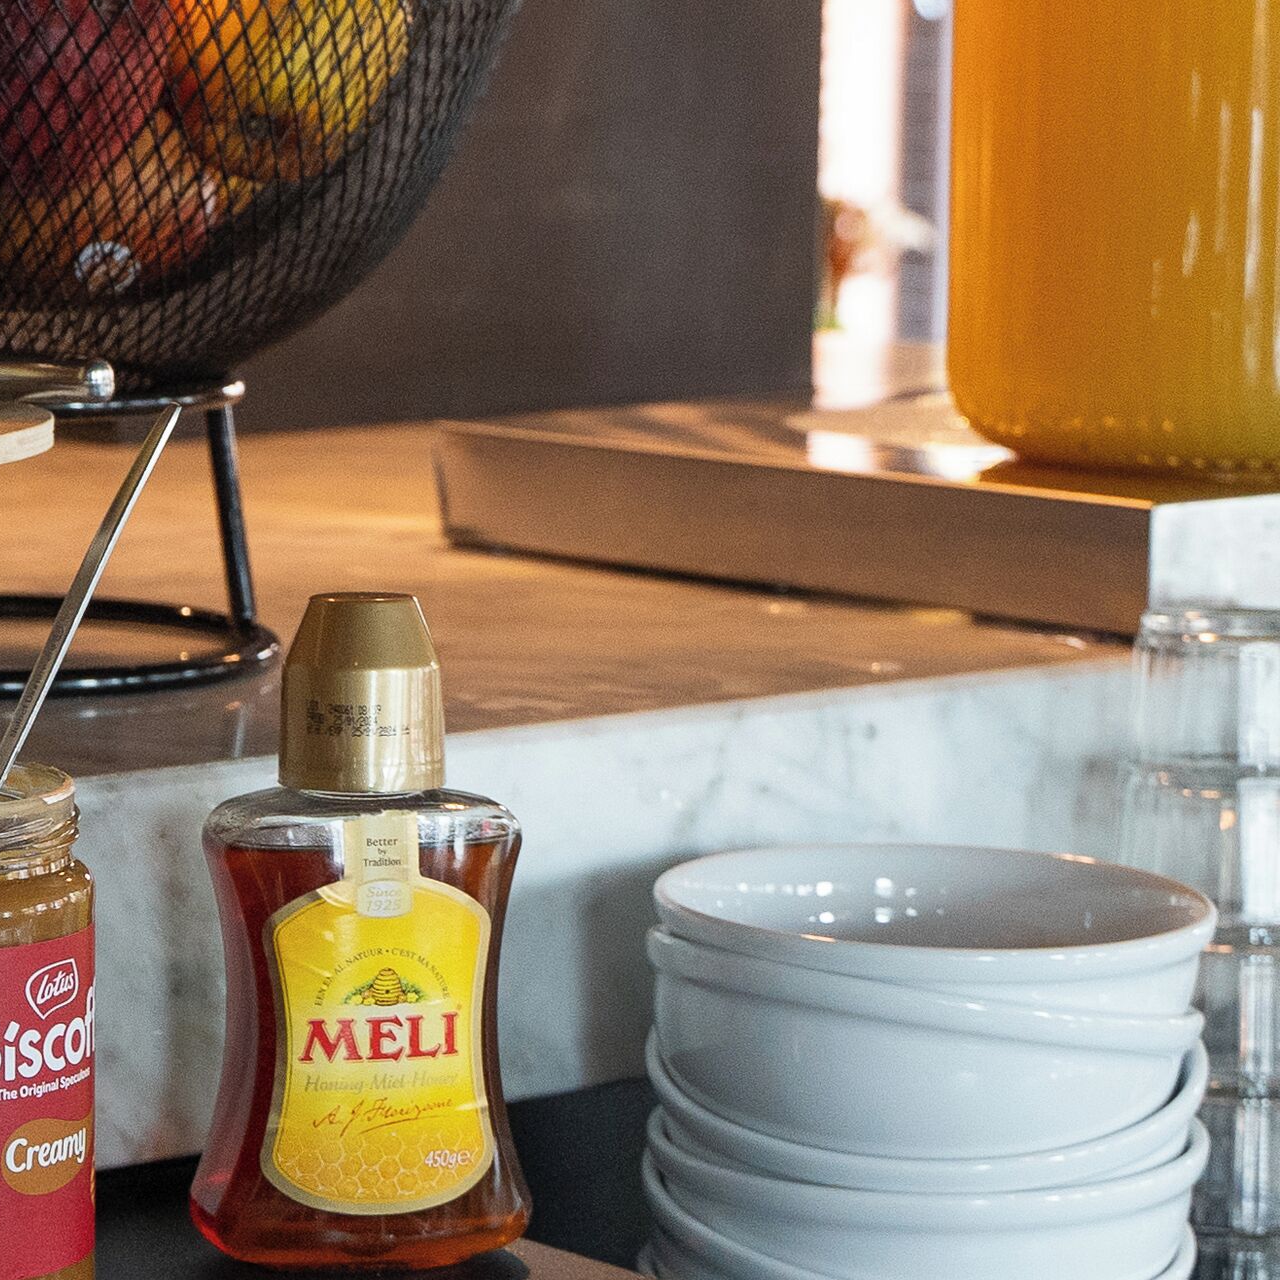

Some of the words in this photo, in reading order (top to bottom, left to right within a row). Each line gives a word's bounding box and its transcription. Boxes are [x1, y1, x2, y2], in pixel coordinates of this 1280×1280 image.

[366, 838, 398, 847] Better
[377, 848, 387, 856] by
[363, 858, 402, 867] Tradition
[345, 947, 383, 967] NATUUR
[36, 970, 74, 1005] Lotus
[298, 1011, 459, 1064] MELI
[19, 1078, 60, 1098] Original
[5, 1127, 86, 1173] Creamy
